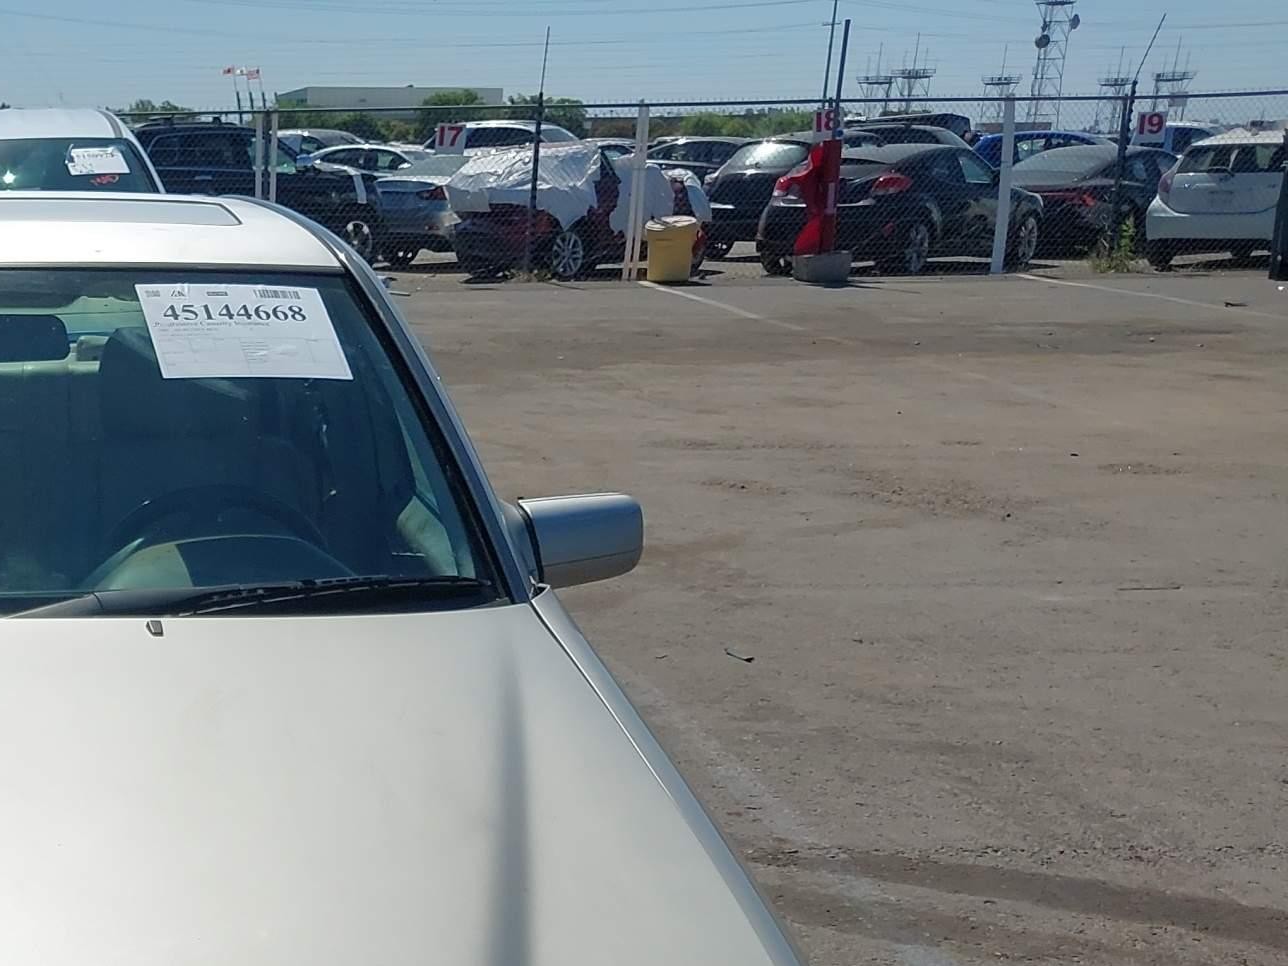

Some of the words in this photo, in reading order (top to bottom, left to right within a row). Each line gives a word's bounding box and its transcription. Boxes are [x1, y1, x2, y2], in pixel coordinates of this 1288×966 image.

[815, 110, 841, 133] 18
[1138, 112, 1164, 135] 19
[438, 126, 464, 146] 17
[162, 303, 308, 322] 45144668
